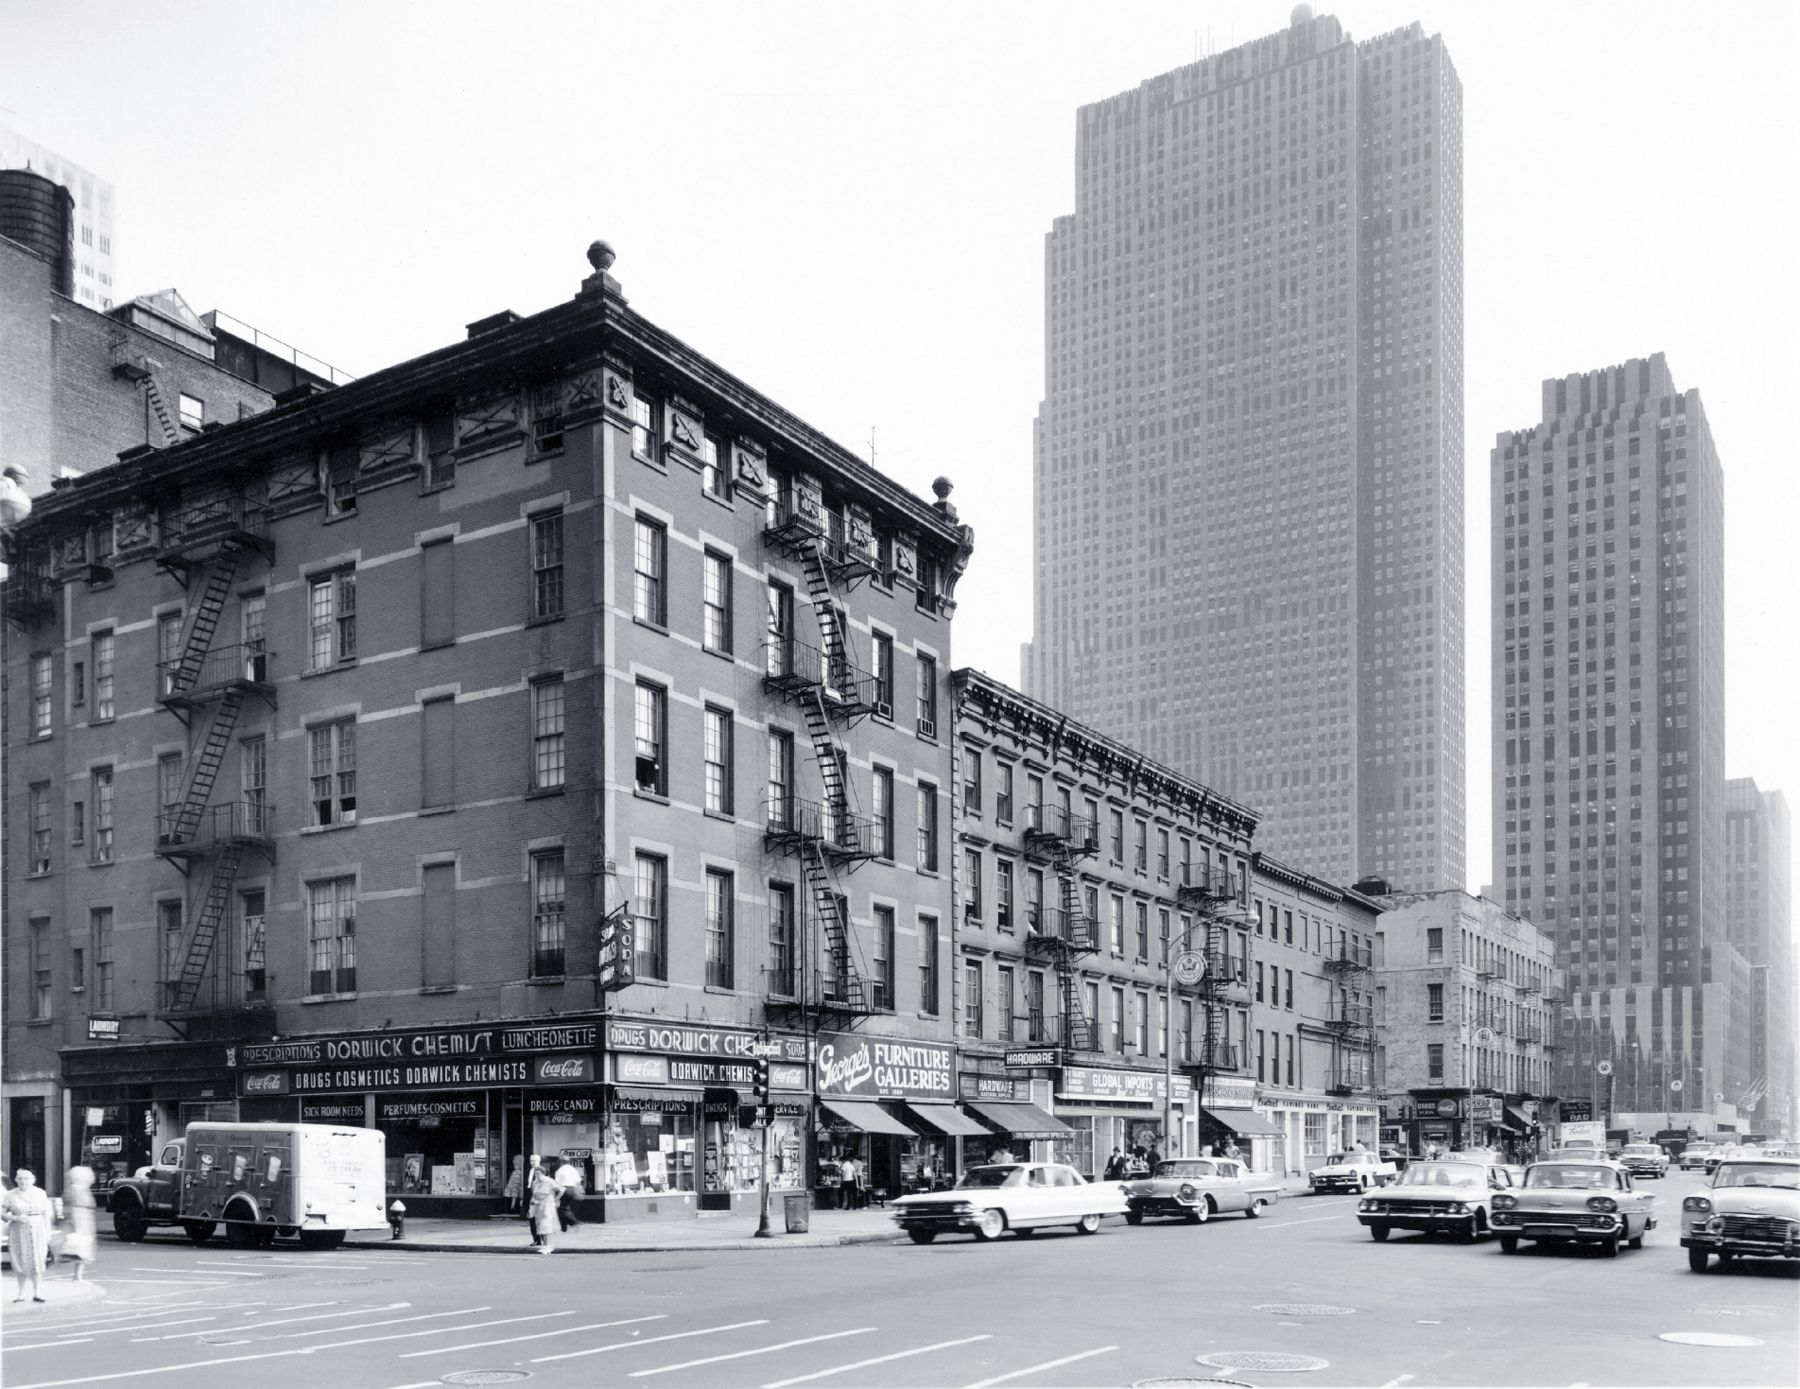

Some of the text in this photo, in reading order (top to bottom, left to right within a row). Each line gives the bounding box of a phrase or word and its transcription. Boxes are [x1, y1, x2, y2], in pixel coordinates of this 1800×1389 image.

[621, 919, 632, 976] SODA
[89, 1019, 119, 1033] LAUNDRY
[1754, 973, 1764, 1076] RADIO CITY
[243, 1028, 597, 1063] PRESCRIPTIONS DORWICK CHEMIST LUNCHEONETTE
[611, 1027, 646, 1046] DRUGS
[649, 1029, 720, 1053] DORWICK
[786, 1043, 805, 1057] SODA
[874, 1043, 951, 1070] FURNITURE
[1006, 1052, 1054, 1065] HARDWARE
[247, 1058, 585, 1091] Coca-Cola DRUGS COSMETICS DORWICK CHEMISTS Coca-Cola
[624, 1059, 802, 1085] Coca-Cola DORWICK CHEMIS Coca-Cola
[819, 1042, 873, 1093] George's
[874, 1065, 951, 1091] GALLERIES
[1092, 1073, 1122, 1089] GLOBAL
[1125, 1076, 1153, 1091] IMPORTS
[978, 1079, 1013, 1093] HARDWARE
[81, 1106, 120, 1117] LDRY
[303, 1104, 364, 1118] SICK ROOM NEEDS
[614, 1100, 687, 1112] PRESCRIPTIONS
[705, 1103, 727, 1113] DRUGS
[773, 1104, 798, 1114] ERVICE
[1258, 1097, 1279, 1108] Central
[1326, 1102, 1344, 1112] Central
[1417, 1102, 1436, 1110] DRUGS
[1570, 1114, 1590, 1122] BAR
